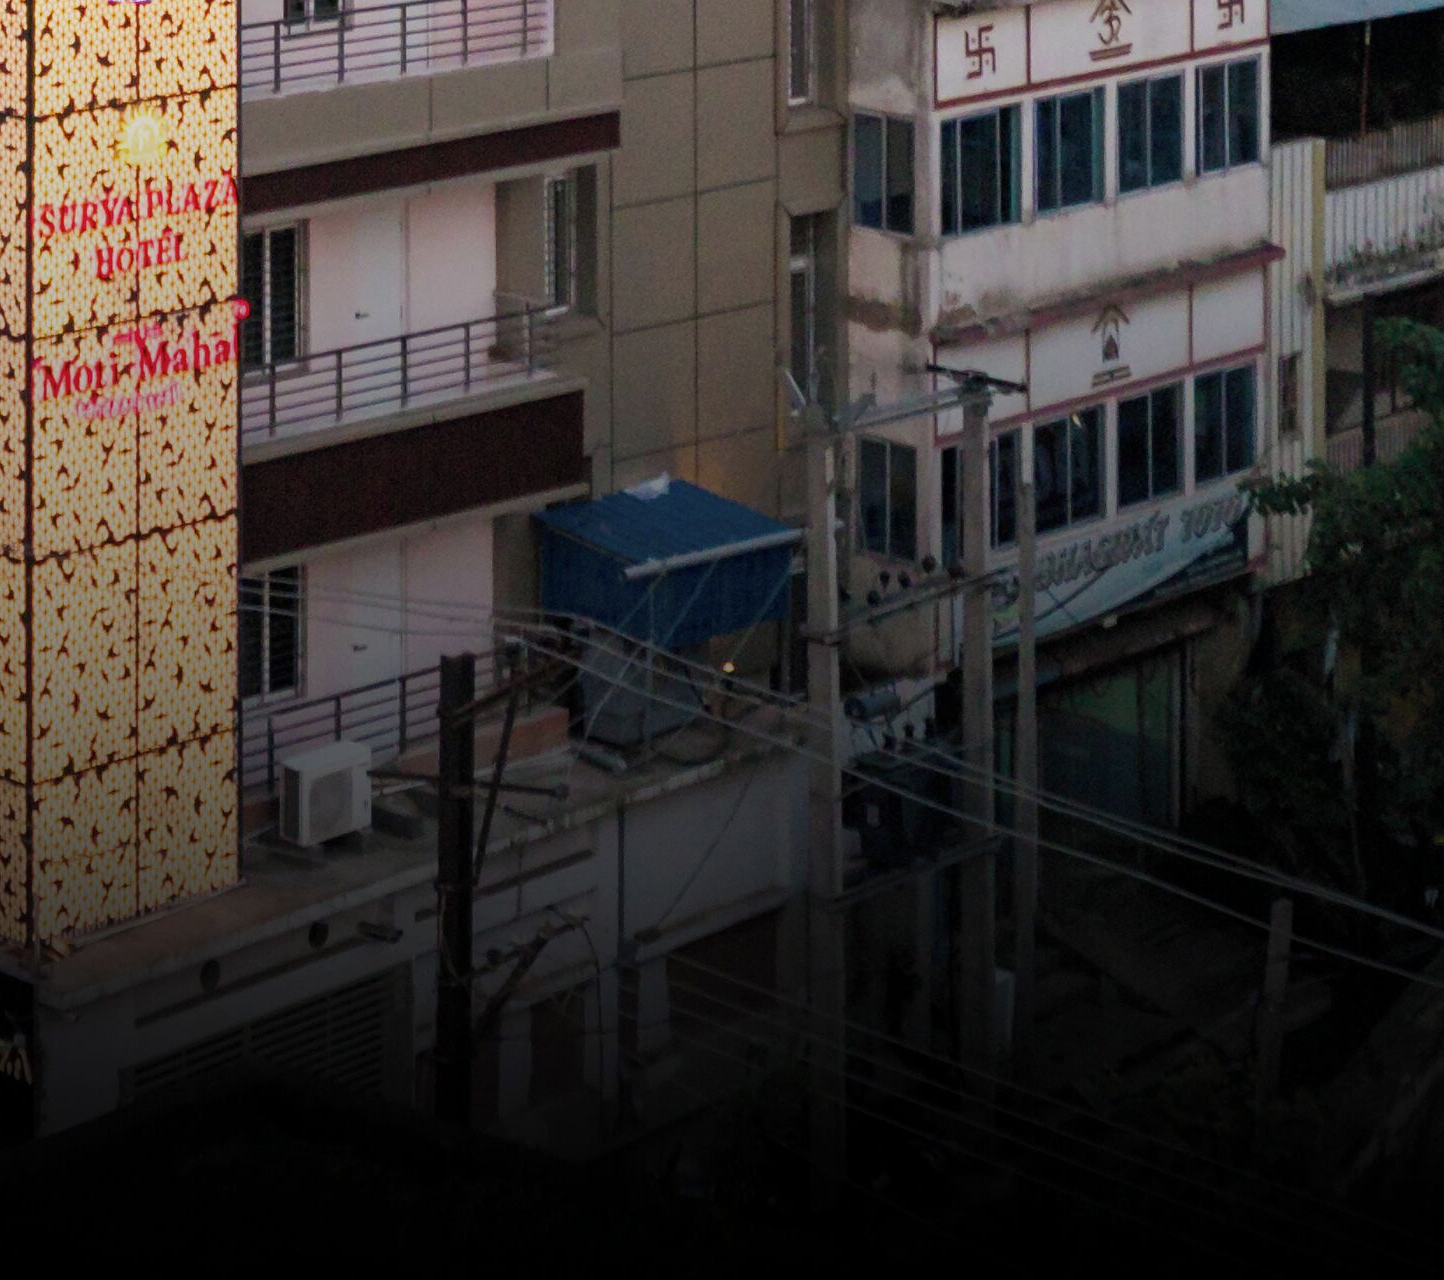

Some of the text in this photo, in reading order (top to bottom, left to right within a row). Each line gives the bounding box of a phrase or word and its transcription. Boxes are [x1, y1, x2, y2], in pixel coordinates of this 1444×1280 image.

[39, 174, 238, 239] SURYA PLAZA
[95, 233, 189, 280] HOTEL
[40, 351, 119, 401] Moti
